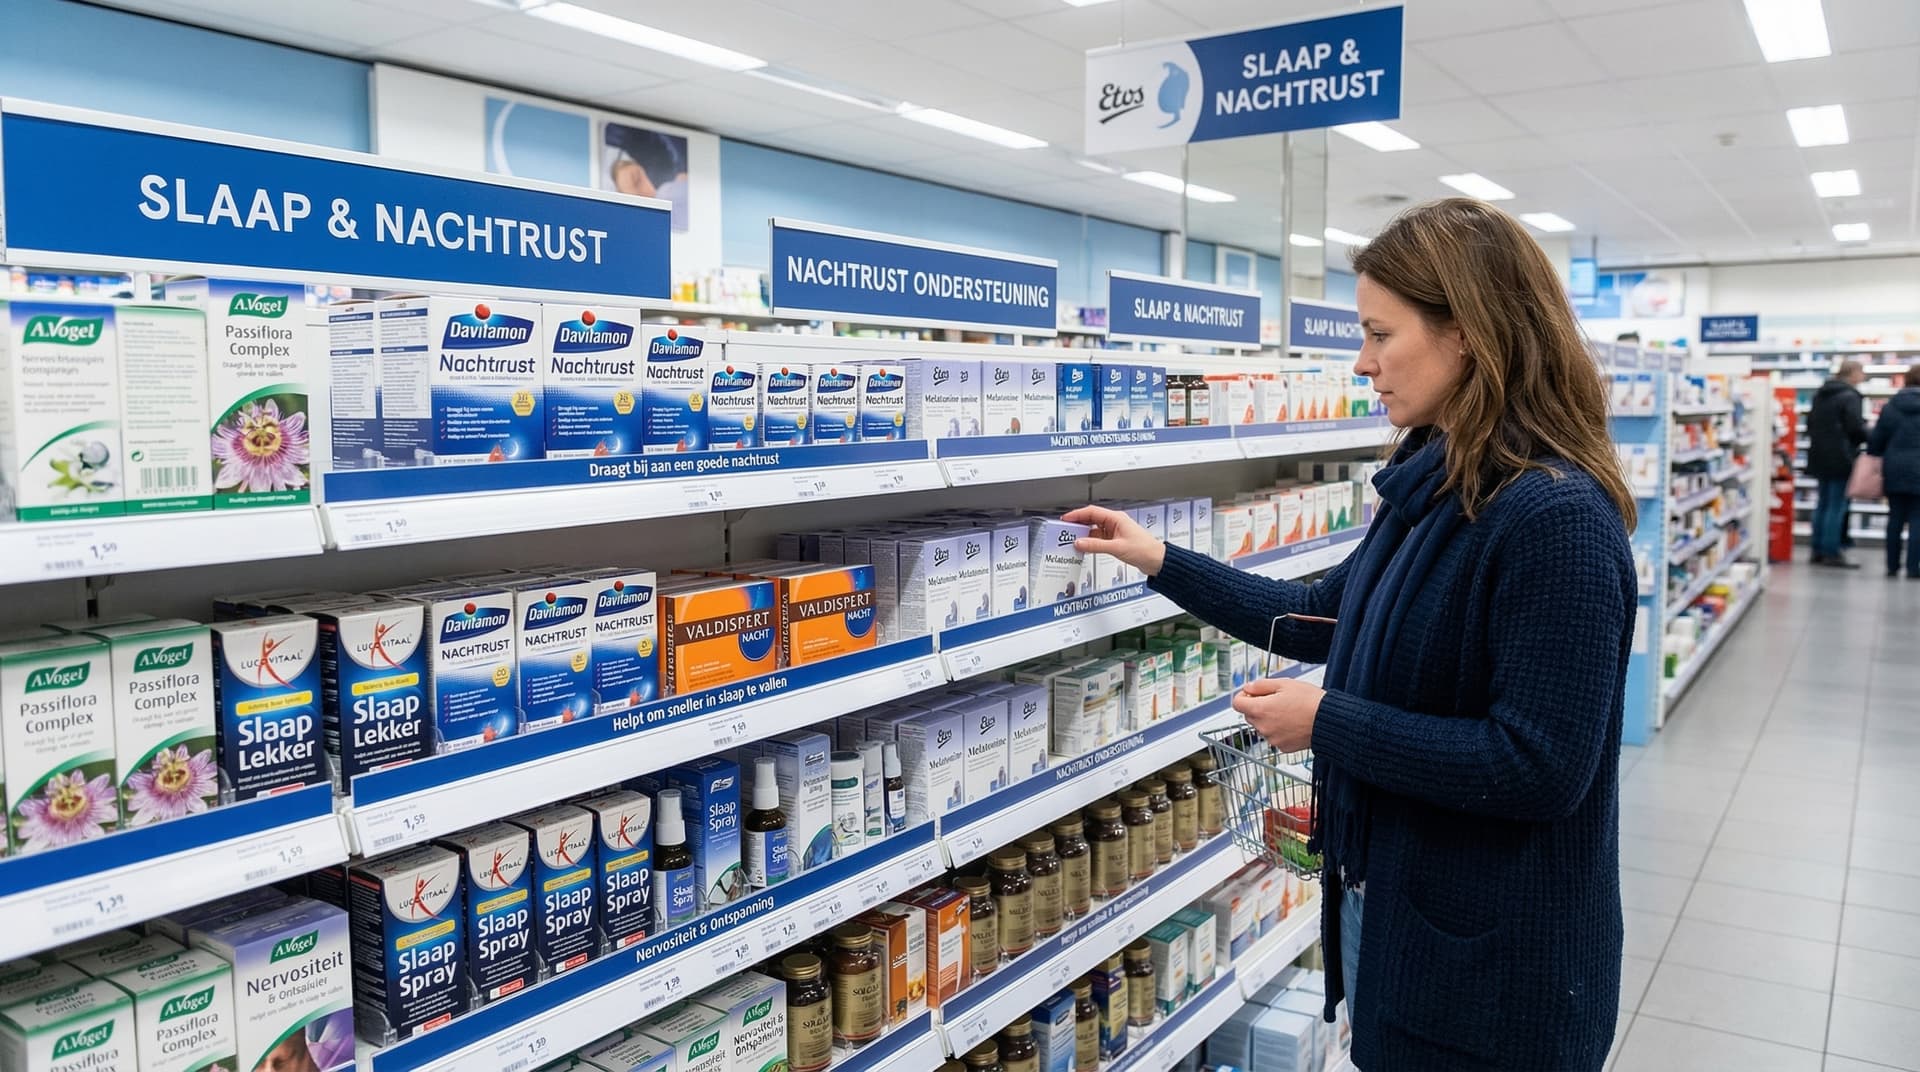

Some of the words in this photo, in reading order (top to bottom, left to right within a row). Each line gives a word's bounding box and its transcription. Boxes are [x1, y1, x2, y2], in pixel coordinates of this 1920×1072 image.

[1242, 43, 1331, 79] SLAAP
[1339, 38, 1361, 65] &
[1098, 83, 1145, 112] Etos
[1215, 69, 1385, 116] NACHTRUST
[138, 173, 312, 234] SLAAP
[327, 198, 359, 240] &
[375, 202, 608, 266] NACHTRUST
[786, 255, 909, 295] NACHTRUST
[913, 271, 1050, 308] ONDERSTEUNING
[235, 298, 284, 314] A.Vogel
[1133, 297, 1171, 320] SLAAP
[1173, 301, 1181, 321] &
[1184, 305, 1245, 328] NACHTRUST
[30, 318, 96, 343] A.Vogel
[224, 324, 294, 341] Passiflora
[229, 342, 290, 359] Complex
[646, 365, 704, 380] Nachtrust
[589, 464, 630, 477] Draagt
[633, 463, 648, 477] bij
[650, 461, 671, 472] aan
[674, 459, 693, 470] een
[696, 455, 729, 472] goede
[731, 453, 780, 468] nachtrust
[799, 592, 871, 617] VALDISPERT
[847, 608, 871, 620] NACHT
[595, 614, 654, 633] NACHTRUST
[686, 612, 769, 641] VALDISPERT
[742, 629, 770, 643] NACHT
[441, 639, 510, 660] NACHTRUST
[525, 627, 587, 647] NACHTRUST
[139, 648, 188, 666] A.Vogel
[31, 668, 84, 687] A.Vogel
[129, 674, 200, 695] Passiflora
[20, 695, 97, 716] Passiflora
[134, 692, 197, 712] Complex
[353, 696, 419, 725] Slaap
[613, 708, 645, 731] Helpt
[647, 703, 665, 721] om
[668, 691, 704, 716] sneller
[706, 694, 717, 706] in
[719, 687, 745, 704] slaap
[747, 684, 757, 697] te
[759, 677, 787, 694] vallen
[25, 712, 94, 734] Complex
[238, 715, 313, 746] Slaap
[354, 719, 421, 748] Lekker
[239, 740, 315, 771] Lekker
[402, 813, 426, 831] 1,59
[709, 801, 736, 818] Slaap
[709, 814, 737, 832] Spray
[606, 868, 649, 893] Slaap
[545, 887, 592, 914] Slaap
[607, 886, 650, 913] Spray
[478, 909, 528, 938] Slaap
[546, 906, 593, 935] Spray
[636, 926, 697, 963] Nervositeit
[699, 924, 708, 935] &
[710, 896, 774, 930] Ontspanning
[275, 934, 313, 956] A.Vogel
[479, 929, 530, 960] Spray
[398, 942, 456, 974] Slaap
[247, 951, 344, 996] Nervositeit
[399, 963, 457, 998] Spray
[165, 993, 209, 1013] A.Vogel
[268, 993, 276, 1004] &
[156, 1012, 218, 1041] Passiflora
[58, 1027, 108, 1053] A.Vogel
